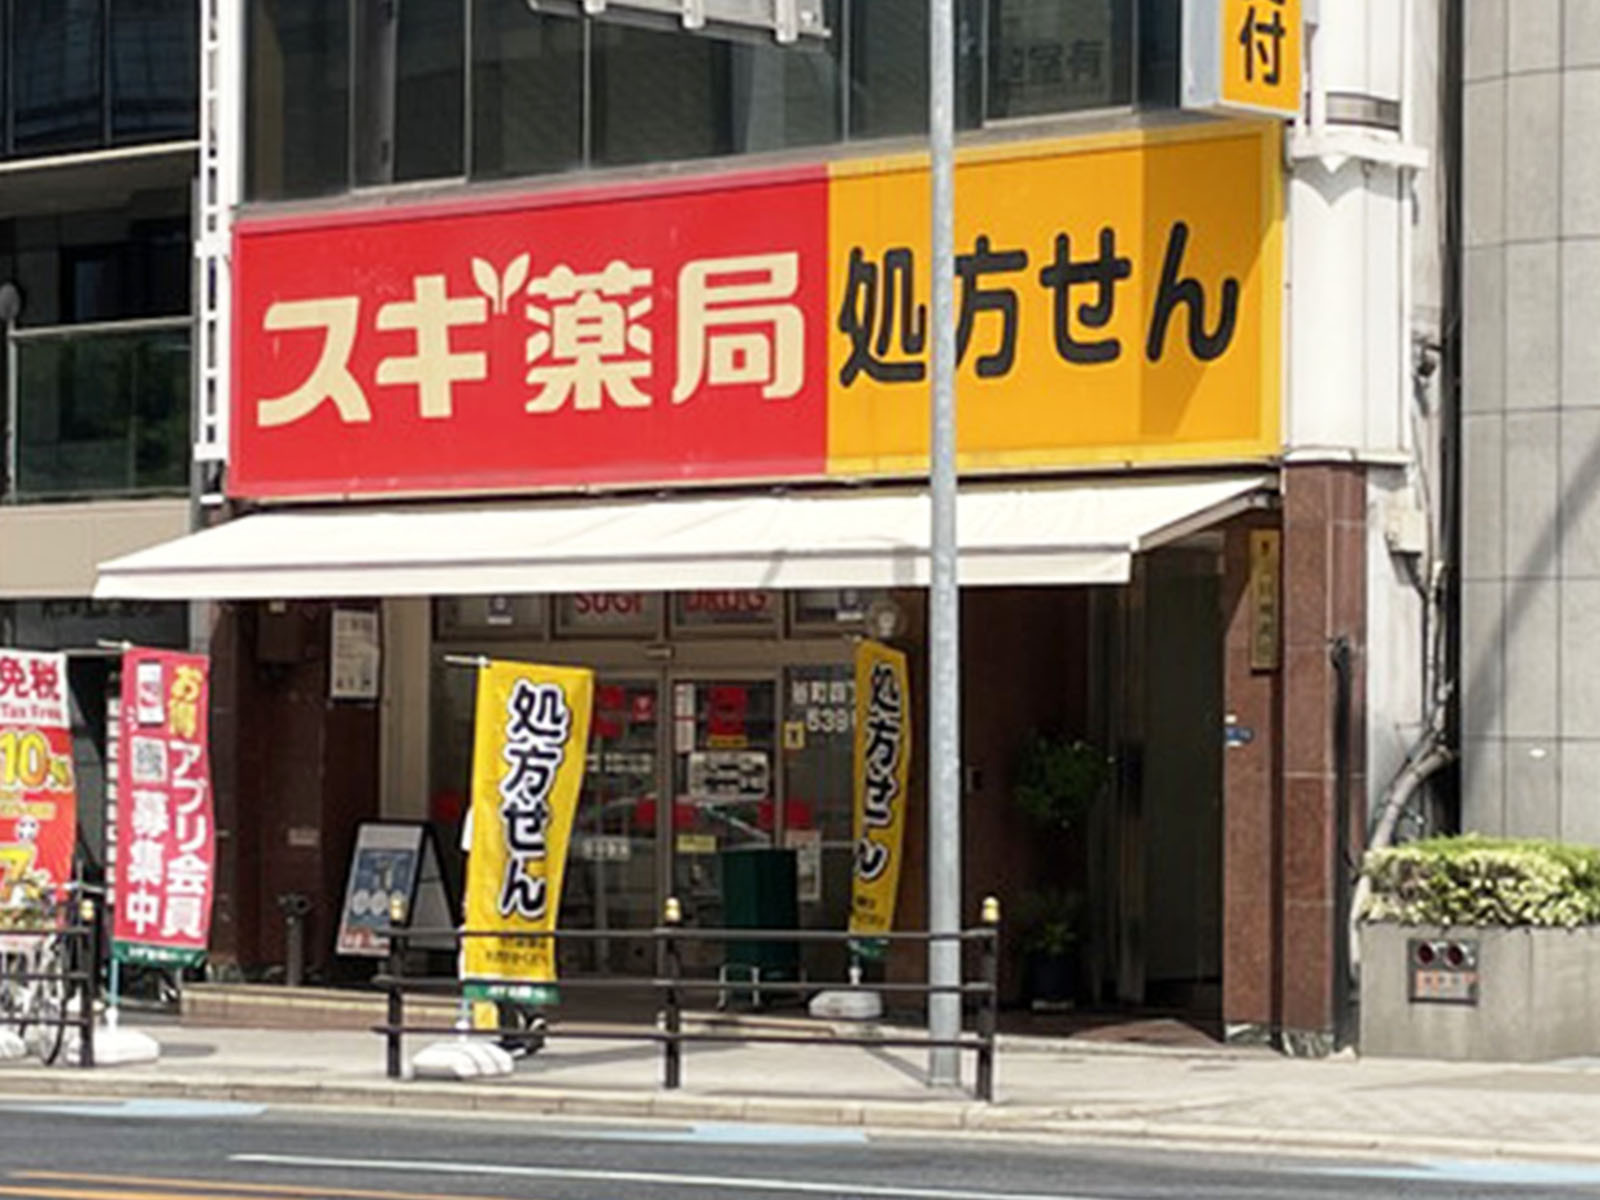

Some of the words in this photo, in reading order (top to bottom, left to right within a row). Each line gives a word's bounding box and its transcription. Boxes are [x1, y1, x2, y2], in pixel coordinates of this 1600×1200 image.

[1239, 0, 1286, 86] 付
[257, 252, 805, 427] スギ薬局
[838, 221, 1240, 388] 処方せん
[0, 656, 61, 701] 免税
[126, 789, 169, 935] 募集中
[499, 677, 569, 920] 処方せん
